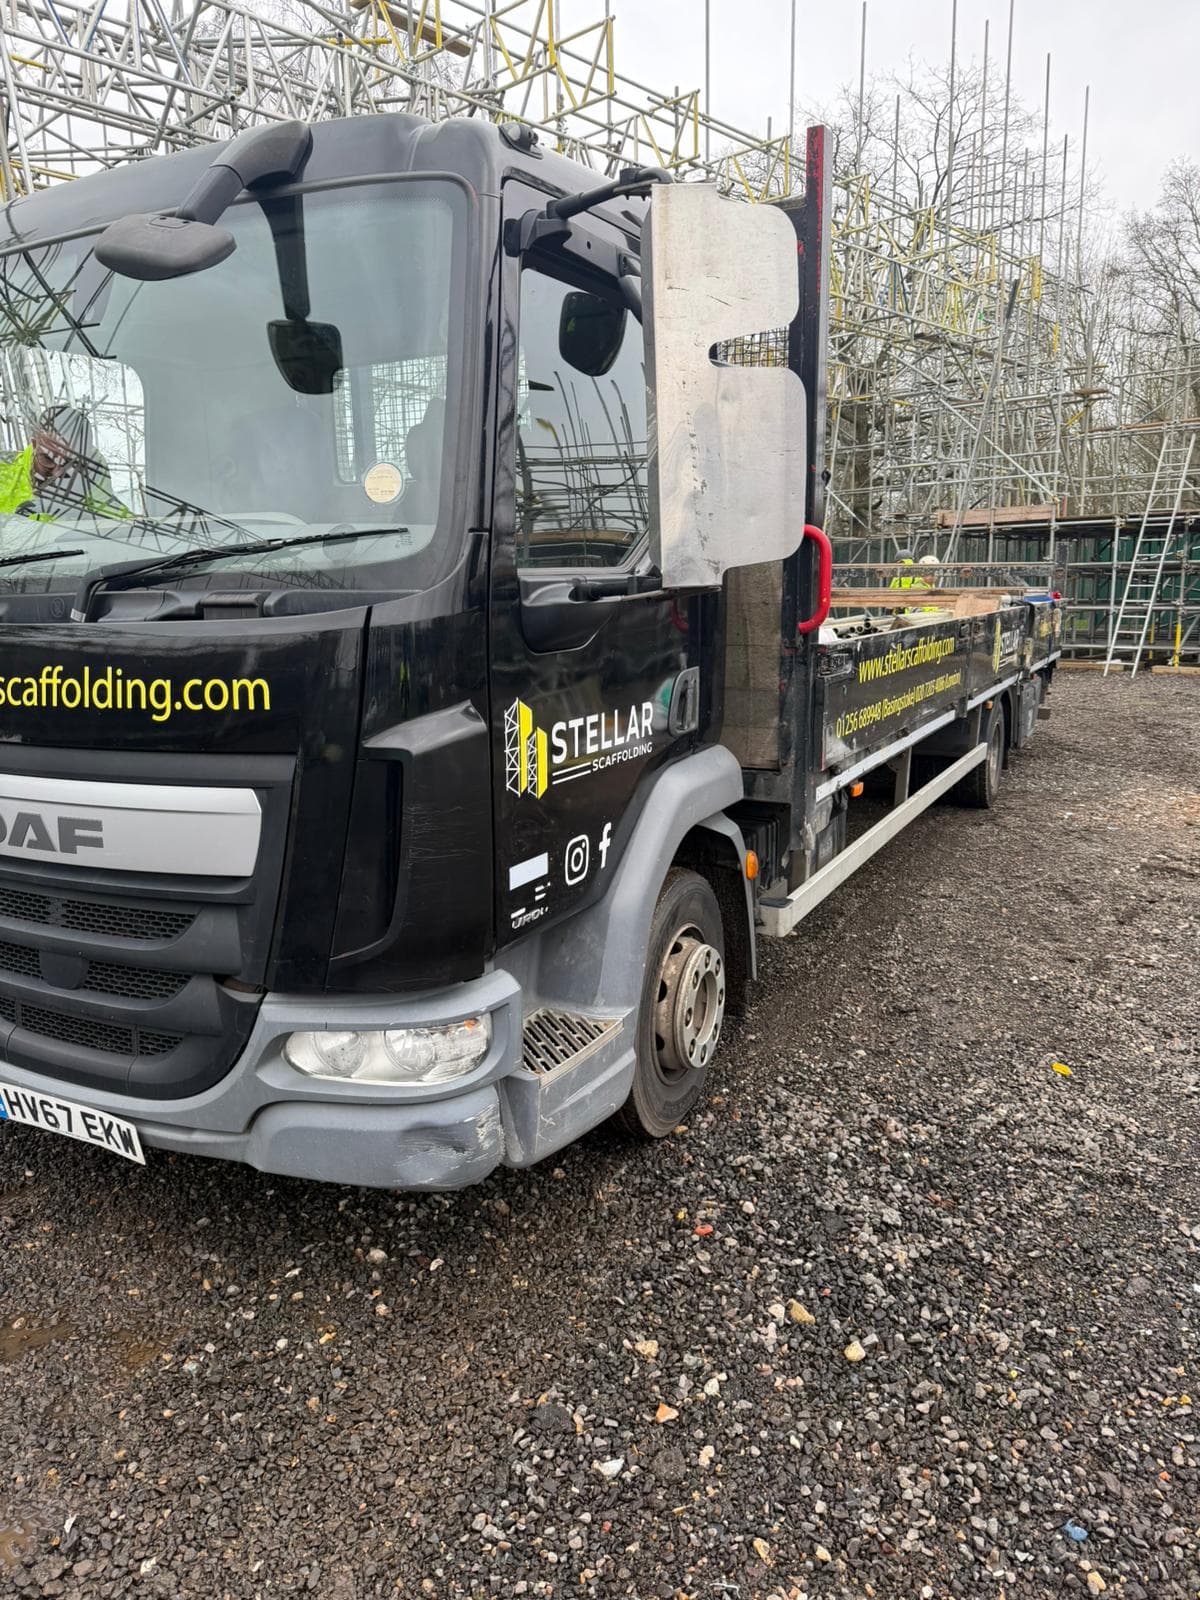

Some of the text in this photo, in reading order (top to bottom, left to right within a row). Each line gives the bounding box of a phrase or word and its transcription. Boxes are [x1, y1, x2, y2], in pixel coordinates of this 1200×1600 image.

[858, 634, 955, 684] www.stellarscaffolding.com
[551, 701, 653, 765] STELLAR
[836, 711, 858, 739] 01256
[592, 741, 653, 772] SCAFFOLDING
[0, 811, 104, 855] AF
[3, 1088, 138, 1157] HV67 EKW
